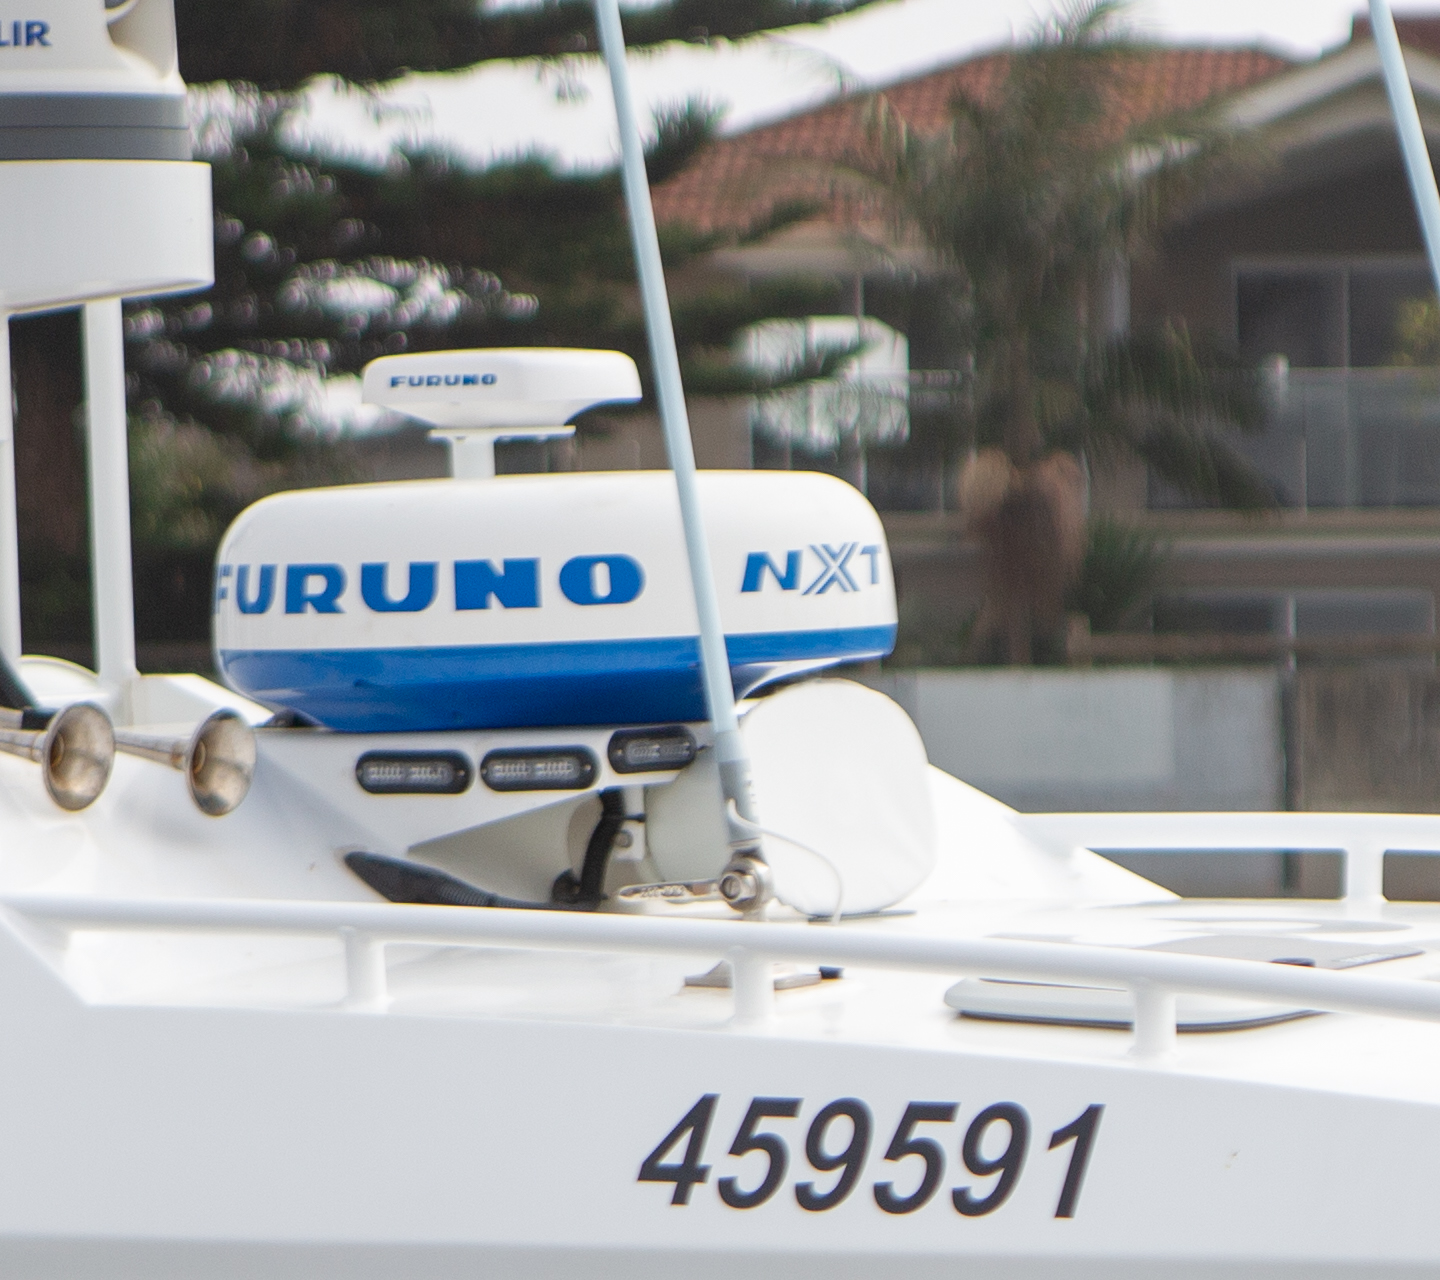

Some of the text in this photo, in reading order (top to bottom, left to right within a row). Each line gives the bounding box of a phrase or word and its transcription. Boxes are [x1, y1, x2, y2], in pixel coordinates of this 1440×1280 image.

[389, 373, 498, 388] FURUNO
[216, 541, 883, 615] FURUNO NXT
[636, 1093, 1108, 1219] 459591
